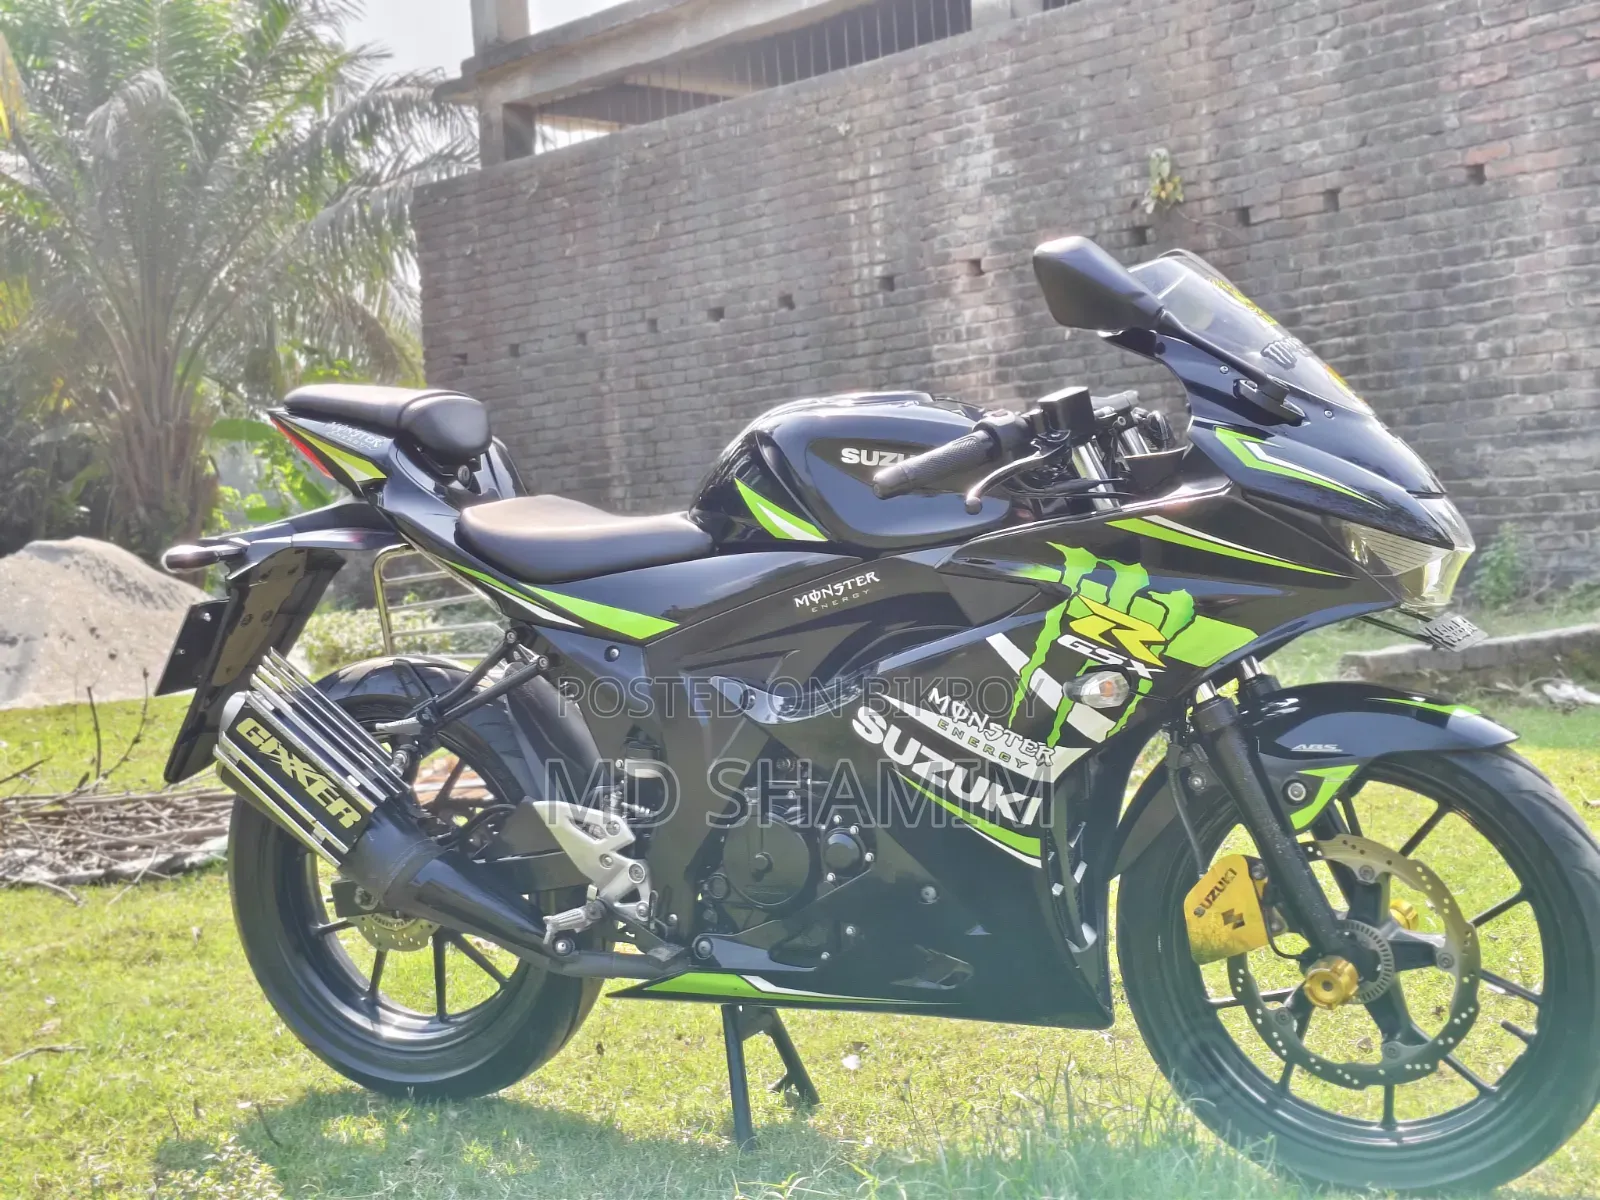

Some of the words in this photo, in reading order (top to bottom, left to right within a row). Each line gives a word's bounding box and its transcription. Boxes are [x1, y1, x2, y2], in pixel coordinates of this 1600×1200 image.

[841, 447, 917, 467] SUZ
[793, 570, 881, 609] MONSTER
[811, 588, 870, 613] ENERGY
[1057, 633, 1167, 680] GSX
[927, 686, 1056, 768] MONSTER
[936, 718, 1030, 769] ENERGY
[1291, 743, 1341, 752] ABS
[235, 717, 362, 829] GIXXER
[851, 705, 1044, 826] SUZUKI
[1193, 867, 1238, 918] SUZUKI
